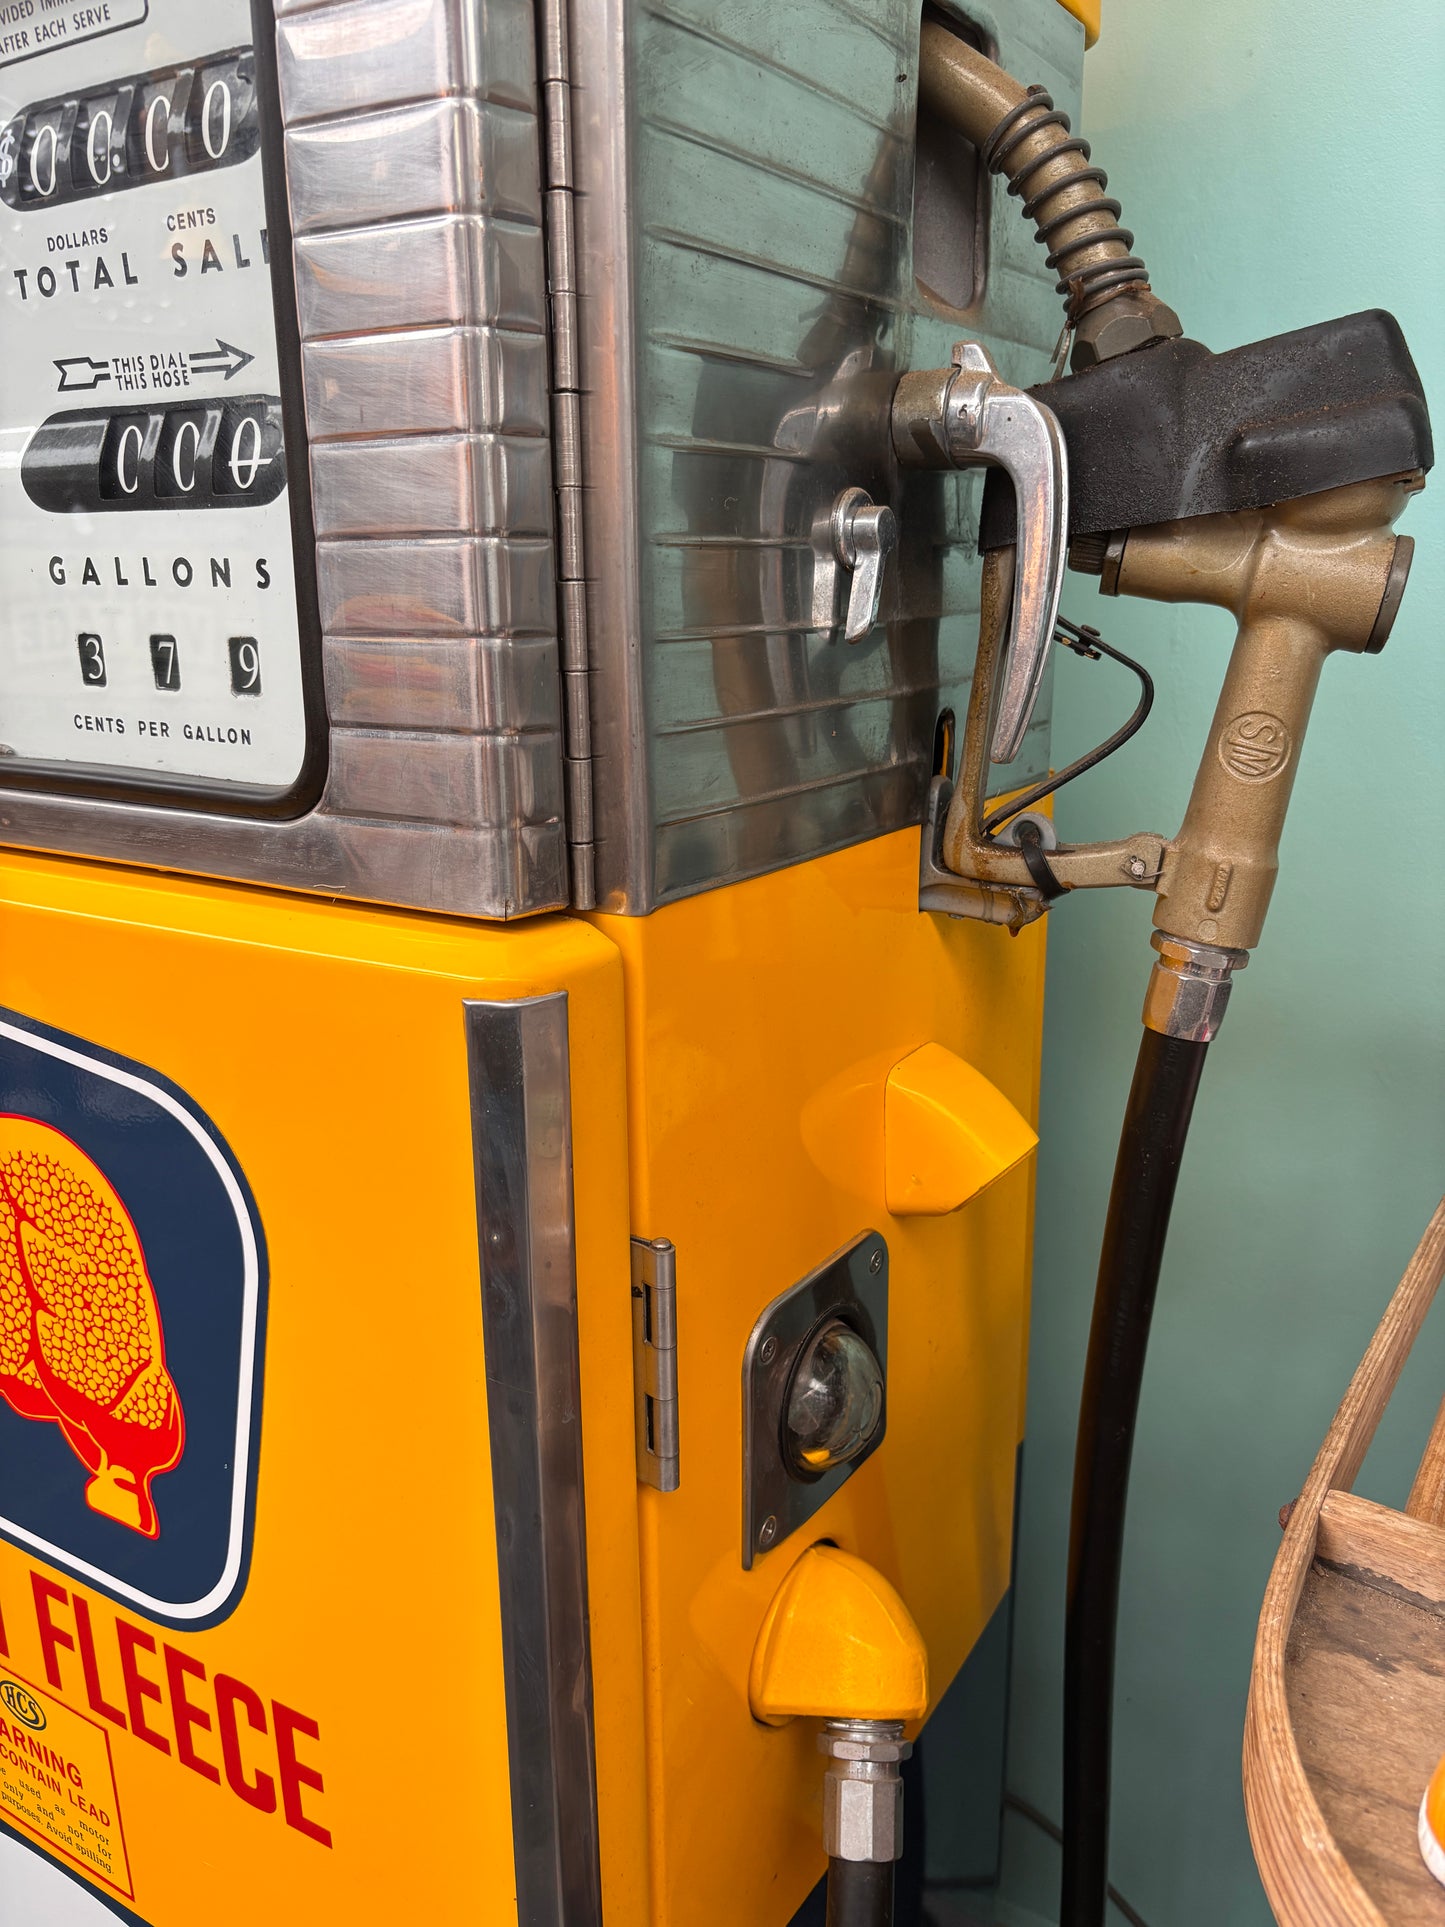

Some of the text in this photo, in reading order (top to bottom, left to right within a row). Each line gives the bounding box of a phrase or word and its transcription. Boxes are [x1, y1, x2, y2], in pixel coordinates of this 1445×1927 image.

[34, 18, 67, 43] EACH
[73, 3, 111, 31] SERVE
[47, 207, 216, 252] DOLLARS CENTS
[13, 252, 139, 300] TOTAL
[112, 352, 188, 374] THIS DIAL
[115, 368, 190, 391] THIS HOSE
[48, 556, 271, 589] GALLONS
[73, 714, 251, 746] CENTS PER GALLON
[4, 1686, 40, 1726] HCS
[29, 1569, 333, 1850] FLEECE
[3, 1780, 112, 1860] only and not for
[18, 1778, 42, 1800] used
[54, 1803, 66, 1817] as
[78, 1820, 110, 1846] motor
[68, 1788, 111, 1828] LEAD
[46, 1821, 73, 1847] Avoid
[75, 1841, 115, 1874] spilling.
